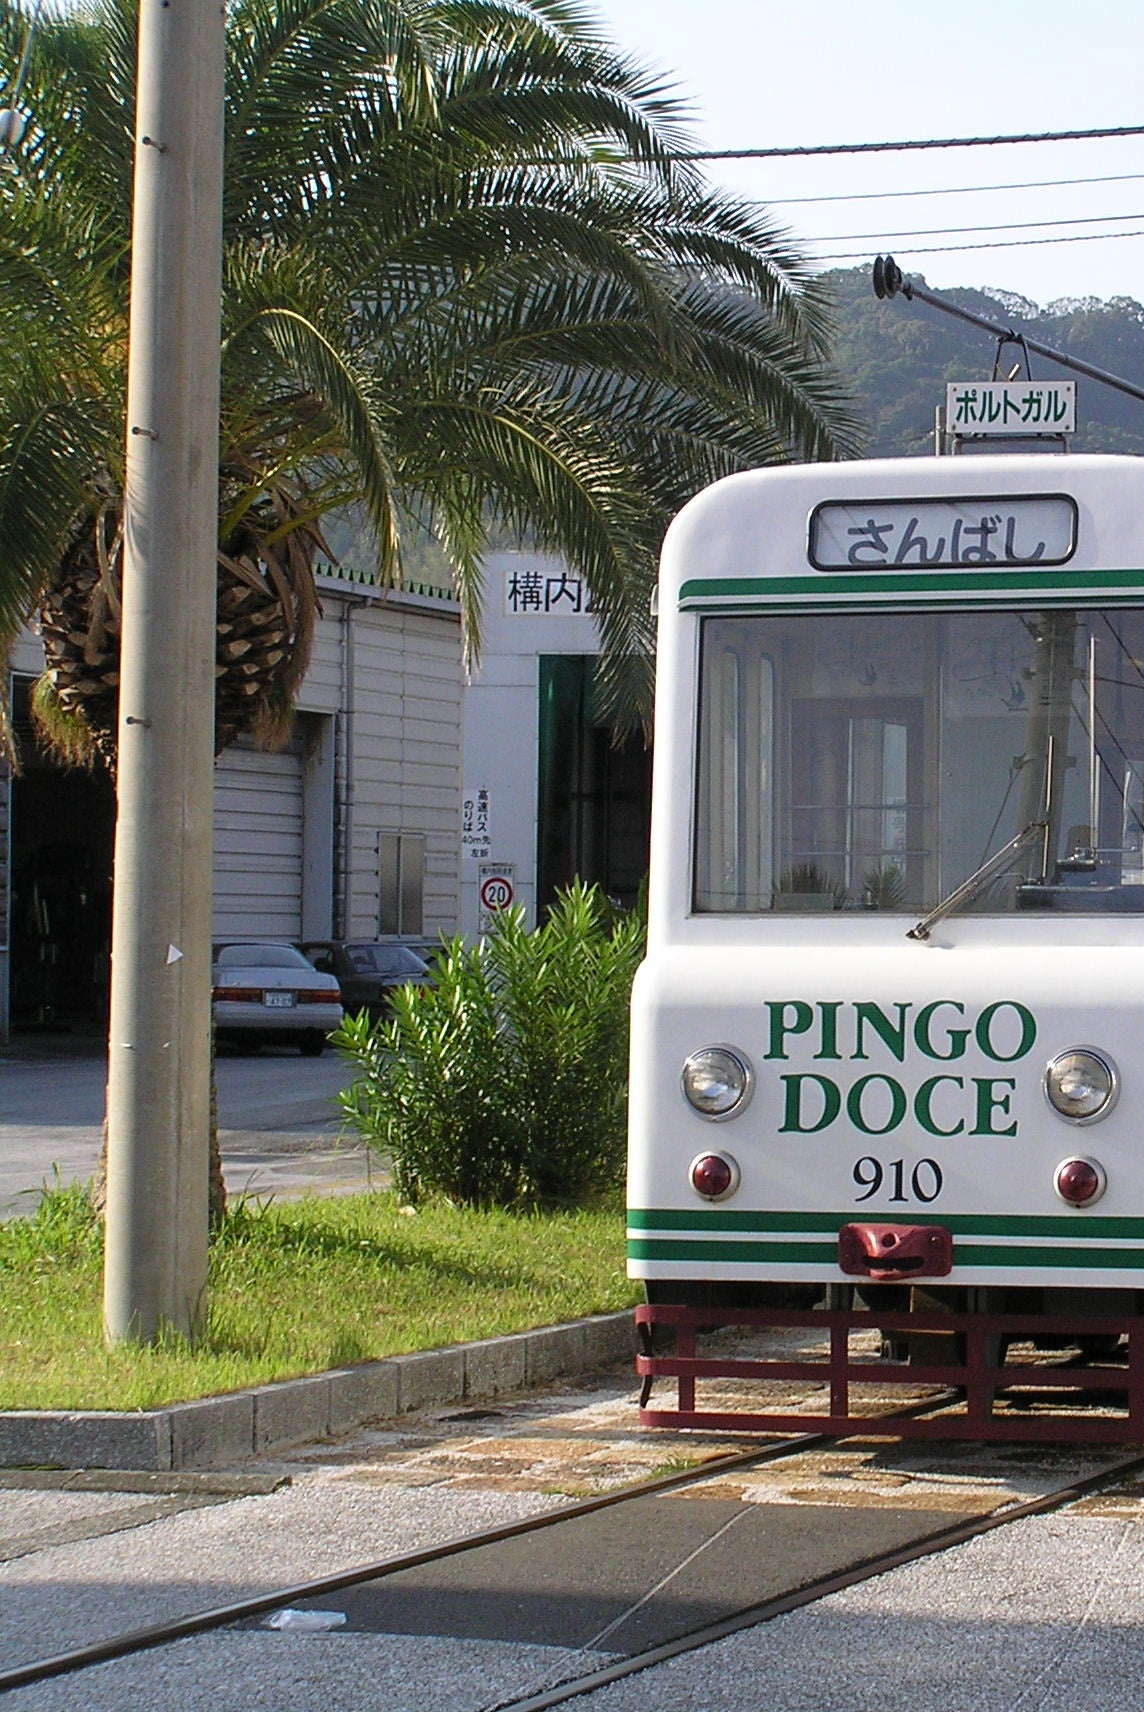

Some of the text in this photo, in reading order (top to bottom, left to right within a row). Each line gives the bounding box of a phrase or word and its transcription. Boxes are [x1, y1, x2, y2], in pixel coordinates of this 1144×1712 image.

[955, 388, 1068, 425] ポルトガル
[847, 514, 1046, 564] さんばし
[508, 571, 600, 613] 構内
[477, 789, 489, 832] 高速バス
[488, 886, 506, 903] 20
[762, 1000, 1038, 1063] PINGO
[777, 1073, 1019, 1139] DOCE
[852, 1155, 944, 1204] 910
